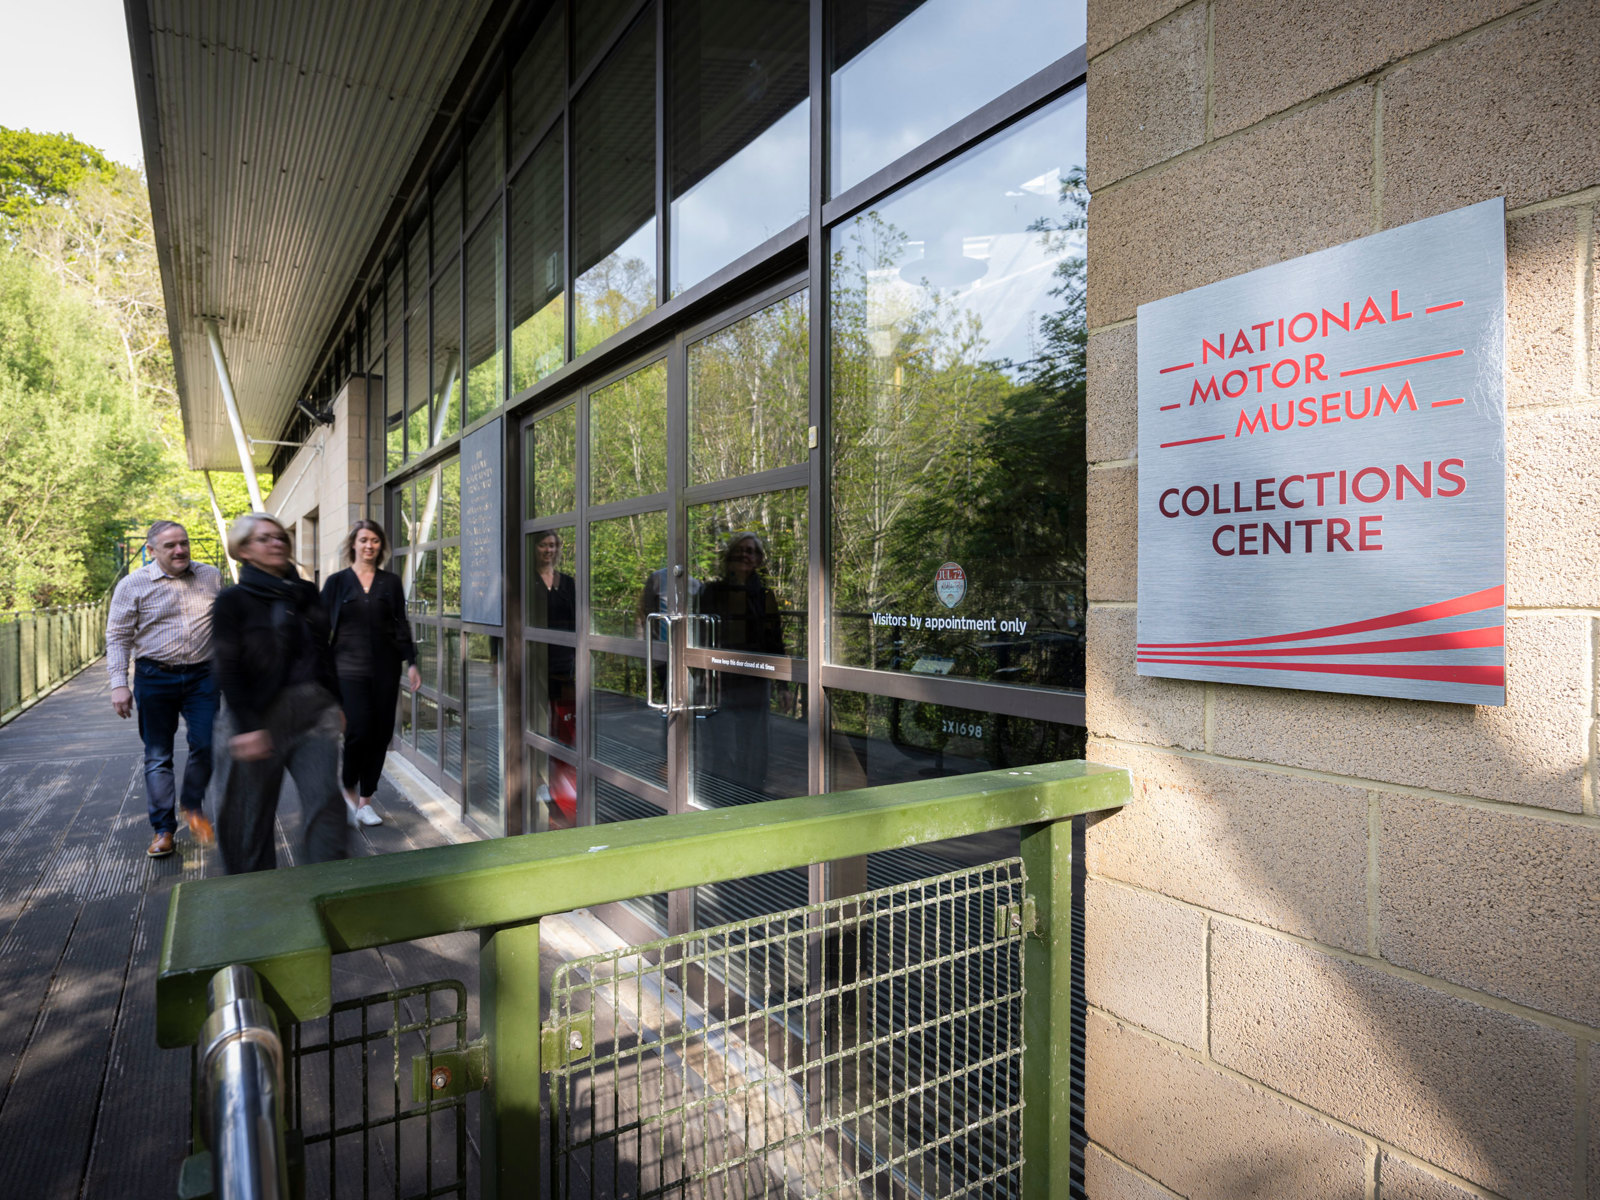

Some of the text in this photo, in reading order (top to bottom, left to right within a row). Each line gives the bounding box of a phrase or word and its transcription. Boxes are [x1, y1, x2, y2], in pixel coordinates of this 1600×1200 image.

[1201, 289, 1413, 365] NATIONAL
[1189, 352, 1329, 406] MOTOR
[1234, 379, 1419, 438] MUSEUM
[1158, 458, 1467, 518] COLLECTIONS
[1212, 515, 1384, 556] CENTRE
[952, 569, 963, 579] 72
[872, 612, 1027, 636] Visitors by appointment only
[711, 656, 722, 664] Please
[722, 658, 730, 666] keep
[765, 663, 775, 671] times
